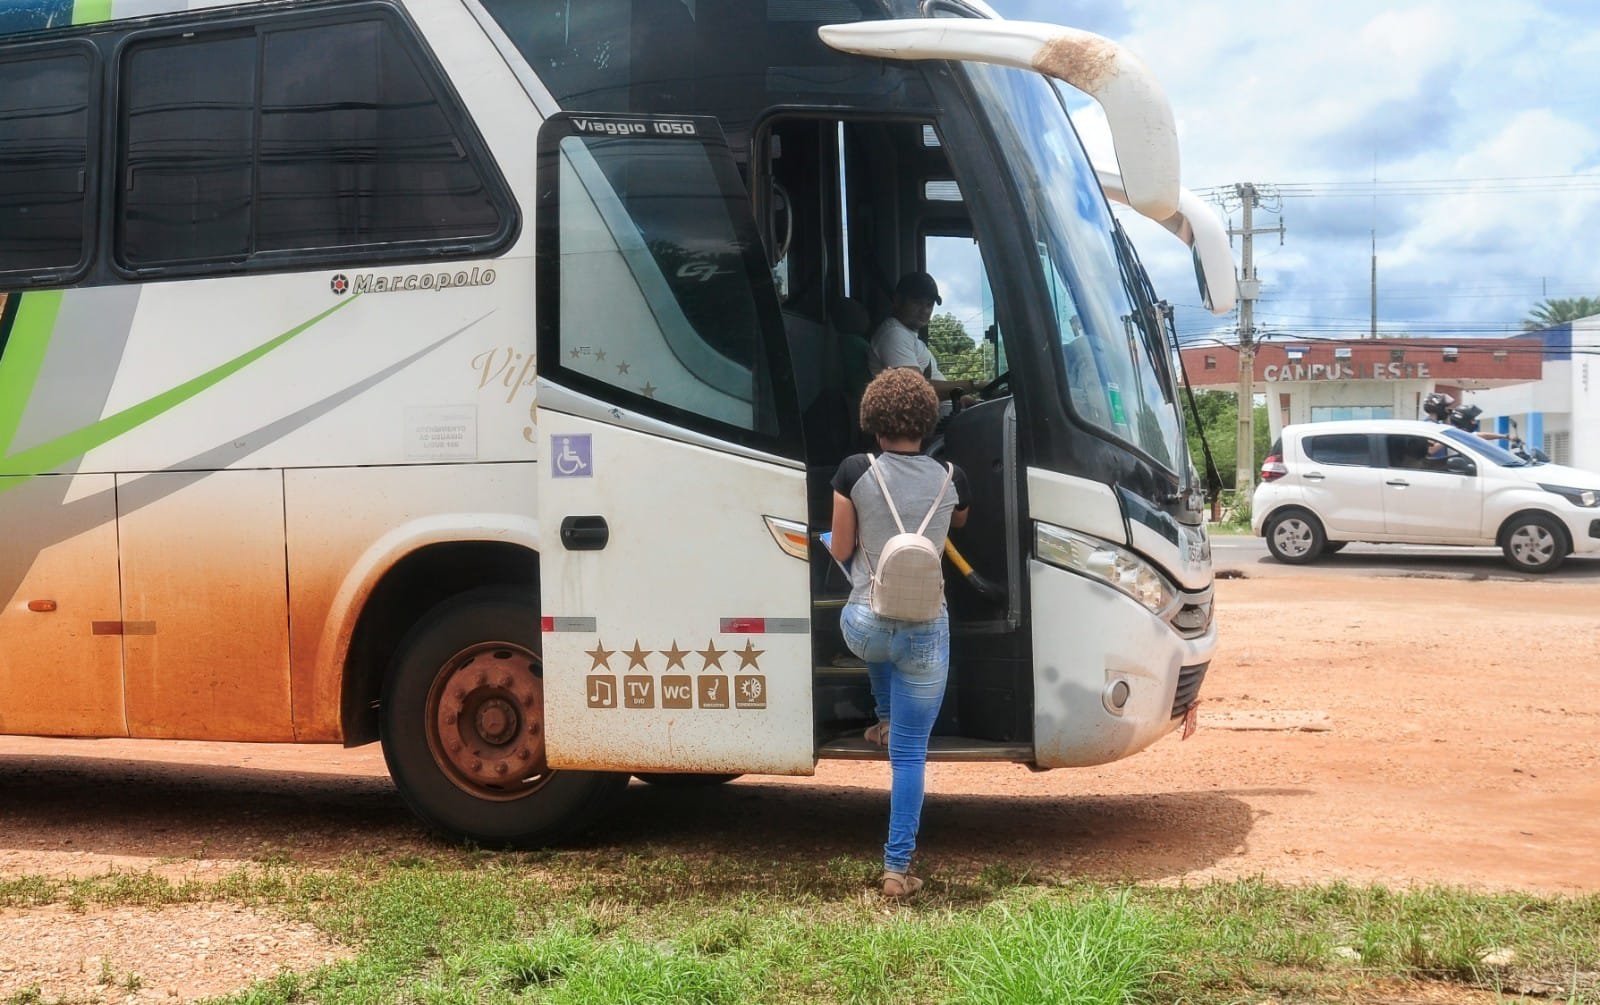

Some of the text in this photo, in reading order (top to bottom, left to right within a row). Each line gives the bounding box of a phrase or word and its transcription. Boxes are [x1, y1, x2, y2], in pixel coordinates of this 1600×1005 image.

[573, 119, 696, 135] Viaggio 1050
[352, 267, 497, 295] Marcopolo
[1264, 362, 1431, 382] CAMPUS LESTE
[627, 682, 650, 697] TV
[664, 686, 690, 699] WC
